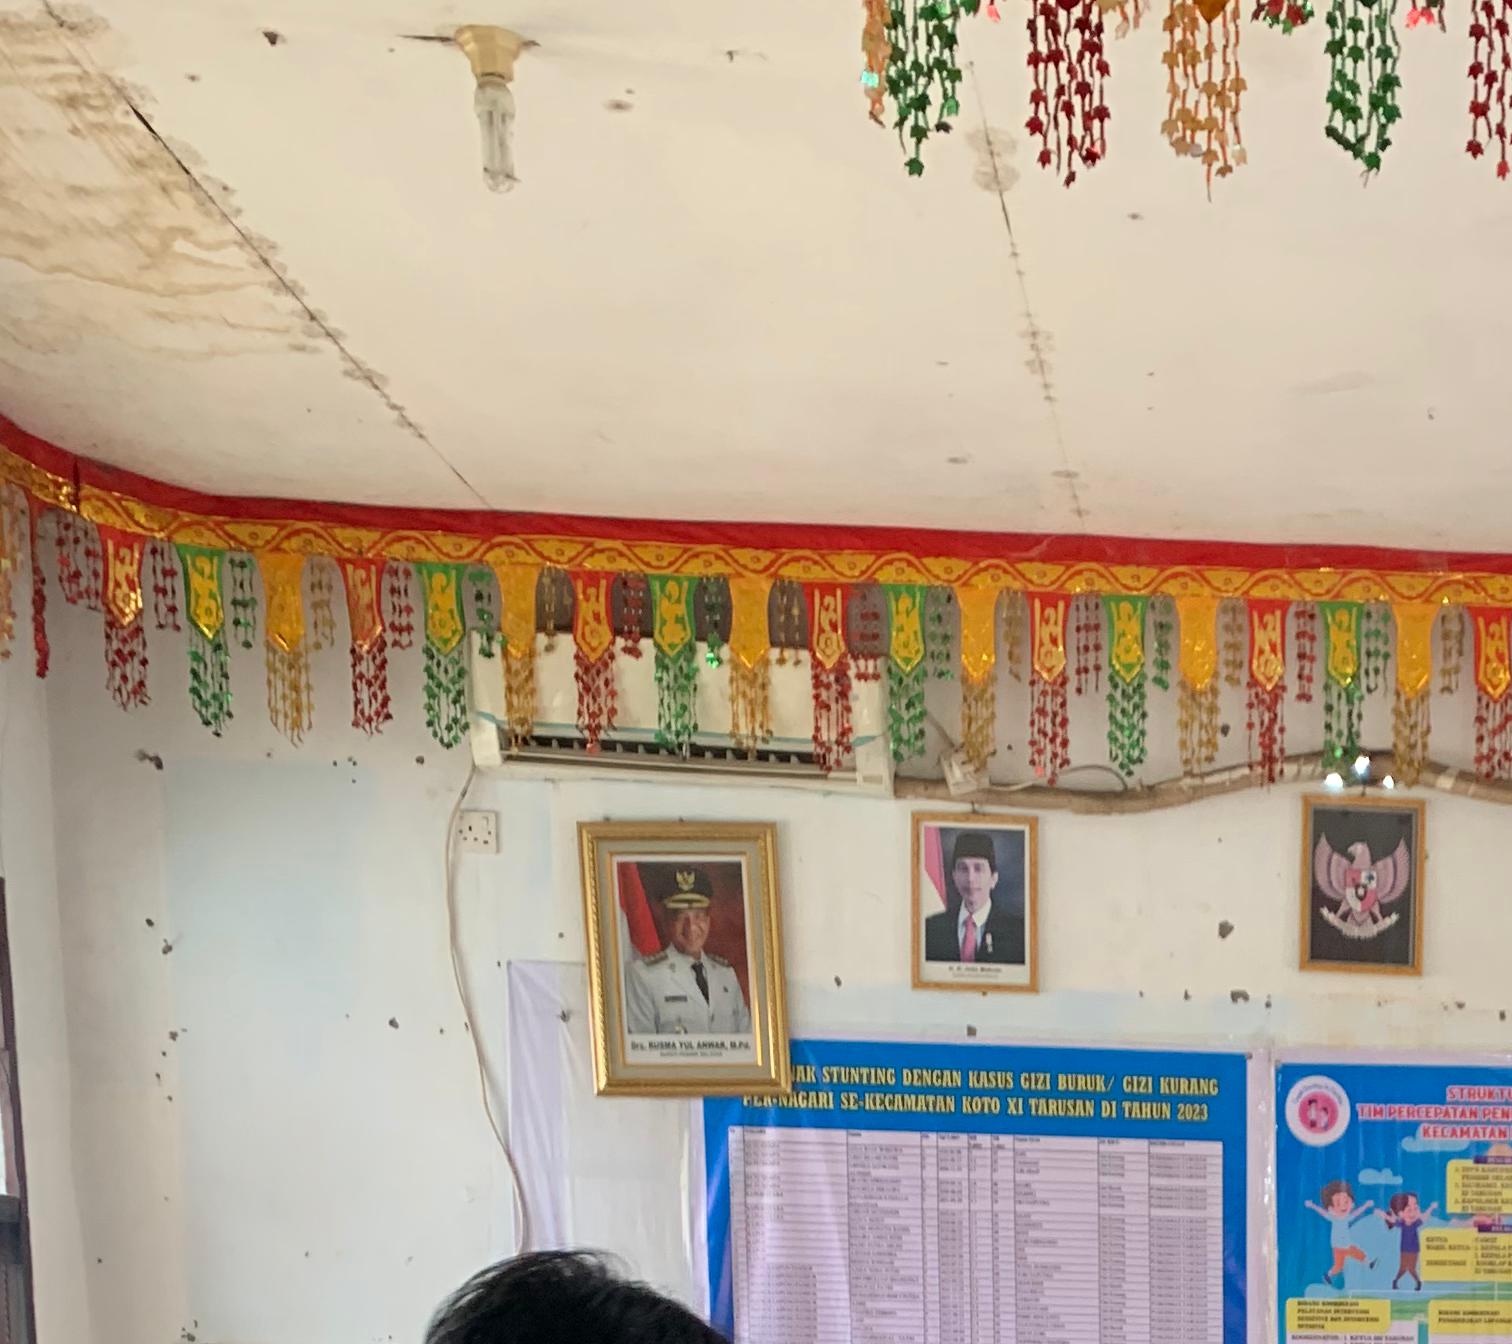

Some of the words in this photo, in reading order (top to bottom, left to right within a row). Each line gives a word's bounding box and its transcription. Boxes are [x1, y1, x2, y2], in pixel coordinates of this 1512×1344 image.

[822, 1066, 896, 1085] STUNTING
[902, 1069, 961, 1088] DENGAN
[968, 1071, 1014, 1090] KASUS
[1020, 1073, 1051, 1090] GIZI
[1057, 1074, 1115, 1093] BURUK/
[1122, 1076, 1153, 1094] GIZI
[1160, 1078, 1219, 1096] KURANG
[840, 1092, 955, 1112] SE-KECAMATAN
[962, 1096, 1000, 1114] KOTO
[1007, 1097, 1024, 1115] XI
[1029, 1098, 1094, 1117] TARUSAN
[1101, 1101, 1117, 1119] DI
[1122, 1101, 1171, 1120] TAHUN
[1177, 1103, 1208, 1121] 2023
[1358, 1105, 1385, 1119] TIM
[1388, 1106, 1477, 1120] PERCEPATAN
[1421, 1125, 1507, 1140] KECAMATAN
